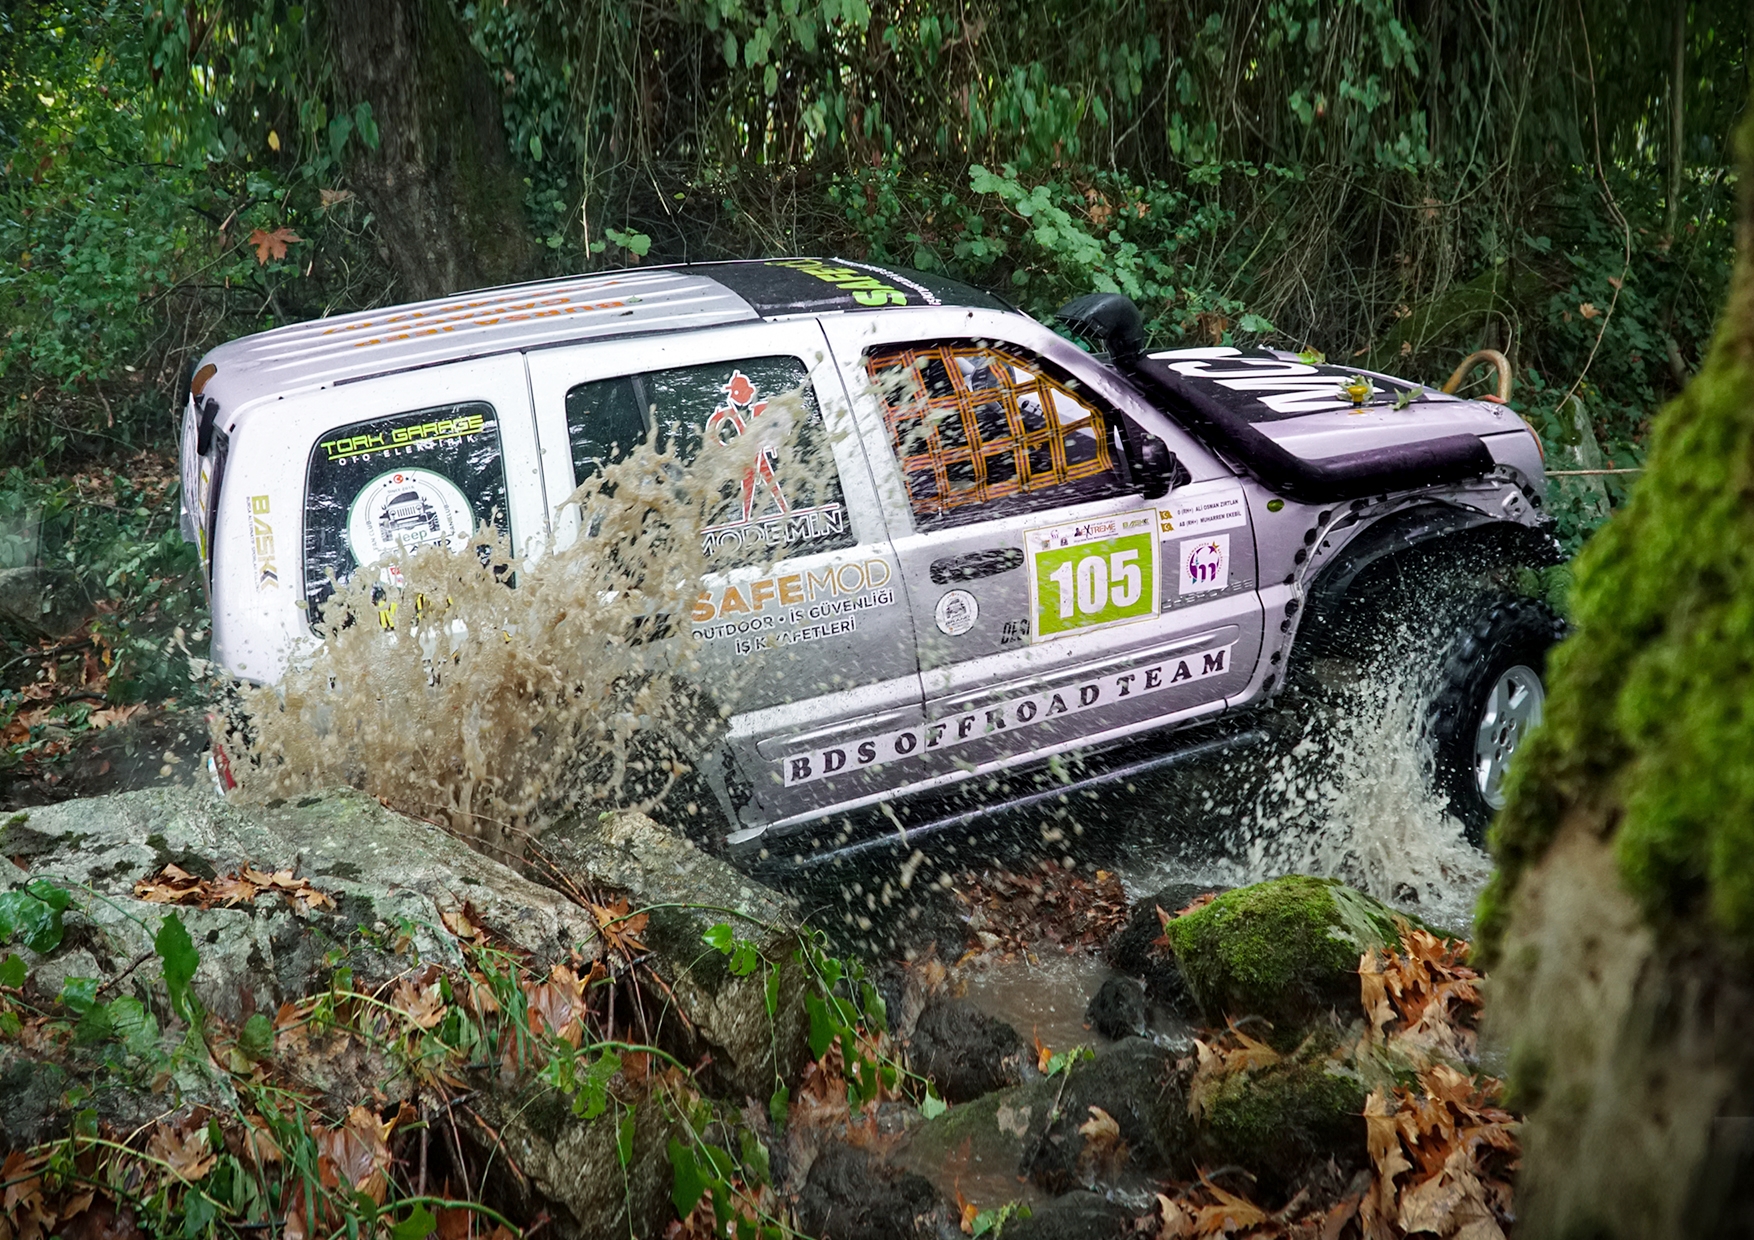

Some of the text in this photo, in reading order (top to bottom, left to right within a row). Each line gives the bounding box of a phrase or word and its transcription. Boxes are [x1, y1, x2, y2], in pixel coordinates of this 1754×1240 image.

[320, 415, 483, 456] TORK GARAGE
[338, 453, 371, 467] OTO
[691, 558, 890, 622] SAFEMOD
[1050, 549, 1142, 620] 105
[755, 618, 856, 650] KAFETLERİ
[789, 649, 1228, 783] BDS OFFROAD TEAM
